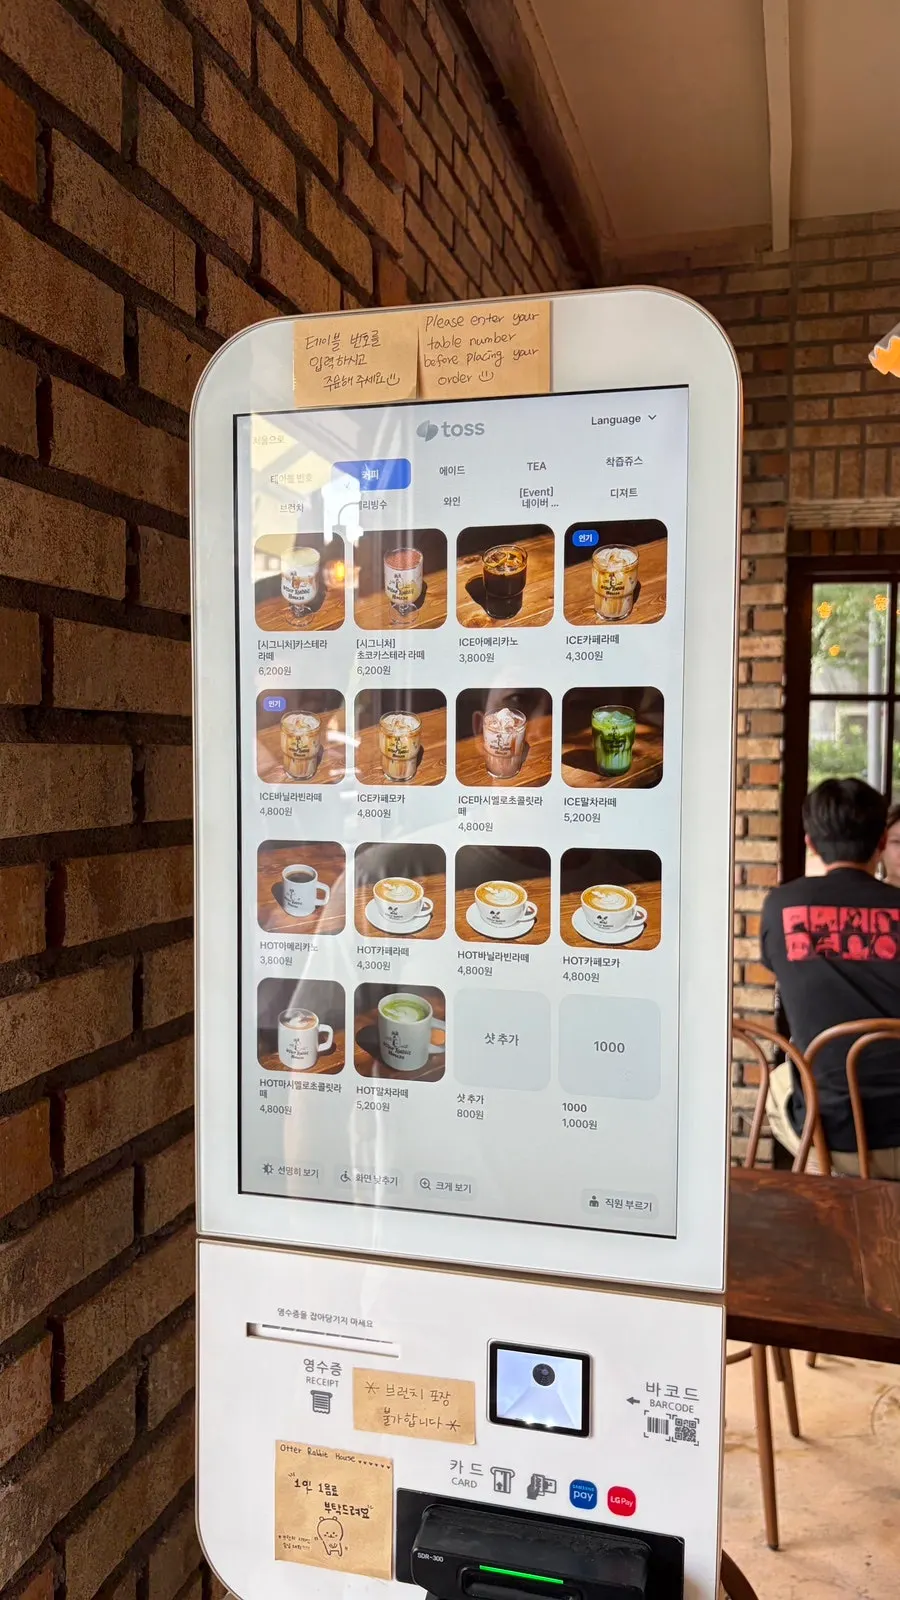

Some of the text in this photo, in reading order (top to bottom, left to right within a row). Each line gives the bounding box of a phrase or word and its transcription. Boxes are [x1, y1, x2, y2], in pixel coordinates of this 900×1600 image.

[471, 313, 504, 326] enter
[512, 312, 540, 326] your
[305, 330, 381, 351] 테이블 번호를
[427, 332, 517, 349] table number
[309, 353, 368, 372] 입력하시고
[424, 353, 459, 368] before
[513, 347, 539, 361] your
[356, 371, 386, 388] 주세요
[438, 372, 473, 385] order
[591, 413, 641, 427] Language
[441, 421, 485, 438] toss
[527, 461, 547, 472] TEA
[605, 456, 643, 468] 착즙쥬스
[439, 465, 466, 477] 에이드
[519, 486, 554, 499] [Event]
[443, 496, 461, 507] 와인
[522, 498, 549, 509] 네이버
[279, 503, 304, 514] 브런치
[578, 533, 593, 544] 인기
[258, 639, 328, 651] [시그니처]카스테라
[356, 638, 396, 649] [시그니처]
[459, 636, 519, 648] ICE아메리카노
[566, 634, 620, 645] ICE카페라떼
[258, 651, 275, 661] 라떼
[357, 650, 425, 661] 초코카스테라 라떼
[459, 652, 495, 664] 3,800원
[565, 650, 604, 662] 4,300원
[258, 665, 292, 676] 6,200원
[356, 665, 391, 676] 6,200원
[268, 699, 281, 709] 인기
[259, 792, 322, 803] ICE바닐라빈라떼
[357, 793, 405, 804] ICE카페모카
[564, 796, 617, 808] ICE말차라떼
[259, 806, 293, 817] 4,800원
[357, 808, 391, 819] 4,800원
[458, 807, 467, 817] 떼
[564, 812, 601, 824] 5,200원
[458, 821, 494, 833] 4,800원
[259, 941, 319, 953] HOT아메리카노
[357, 945, 410, 957] HOT카페라떼
[259, 955, 293, 967] 3,800원
[457, 950, 530, 963] HOT바닐라빈라떼
[562, 956, 621, 968] HOT카페모카
[356, 960, 391, 971] 4,300원
[457, 965, 493, 977] 4,800원
[562, 971, 600, 983] 4,800원
[484, 1032, 520, 1046] 샷 추가
[594, 1041, 625, 1054] 1000
[259, 1089, 268, 1099] 떼
[356, 1086, 409, 1099] HOT말차라떼
[456, 1093, 485, 1105] 샷 추가
[259, 1105, 292, 1116] 4,800원
[356, 1101, 390, 1112] 5,200원
[562, 1102, 588, 1113] 1000
[456, 1108, 485, 1120] 800원
[562, 1118, 598, 1130] 1,000원
[277, 1165, 319, 1179] 선명히 보기
[355, 1173, 373, 1184] 화면
[435, 1180, 472, 1194] 크게 보기
[605, 1197, 652, 1212] 직원 부르기
[277, 1307, 373, 1328] 영수증을 잡아당기지 마세요
[303, 1358, 343, 1377] 영수증
[306, 1376, 339, 1388] RECEIPT
[386, 1384, 452, 1407] 브런치 포장
[646, 1381, 700, 1402] 바코드
[649, 1398, 694, 1414] BARCODE
[383, 1407, 442, 1429] 불가합니다
[279, 1443, 303, 1454] Otter
[335, 1452, 356, 1463] House
[450, 1459, 485, 1477] 카드
[451, 1477, 478, 1489] CARD
[573, 1490, 594, 1502] pay
[610, 1495, 634, 1508] LG Pay
[324, 1501, 370, 1519] 부탁드려요
[416, 1551, 444, 1563] SDR-300
